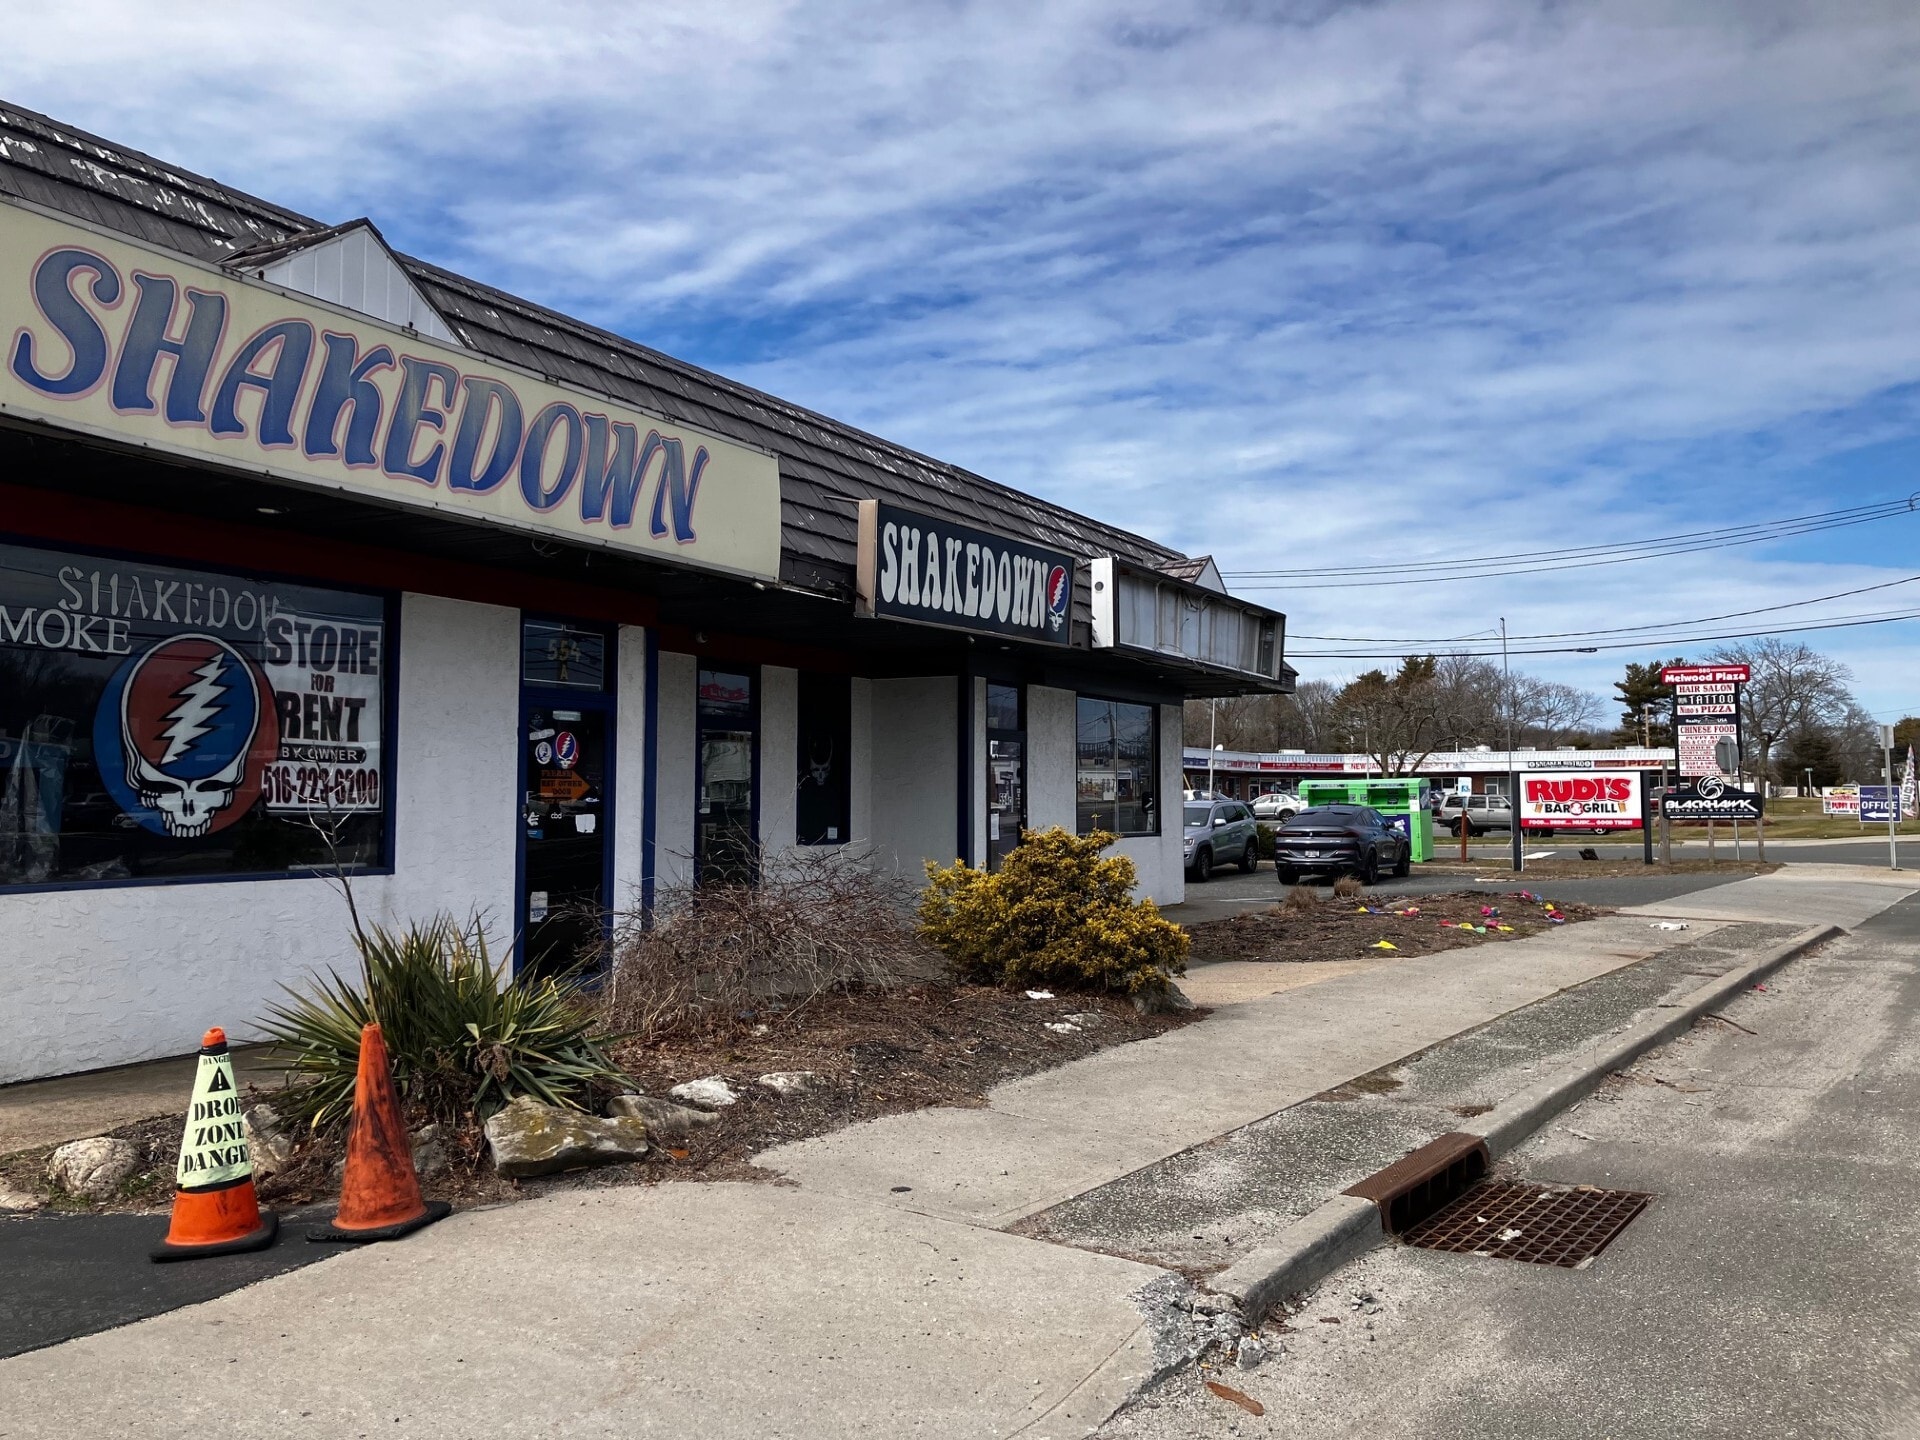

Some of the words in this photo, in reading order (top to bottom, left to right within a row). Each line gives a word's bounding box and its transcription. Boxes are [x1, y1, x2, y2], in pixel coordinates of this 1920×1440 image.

[8, 244, 710, 546] SHAKEDOWN
[881, 521, 1048, 630] SHAKEDOWN
[58, 566, 281, 632] SHAKEDOW
[0, 604, 132, 655] MOKE
[266, 616, 380, 676] STORE
[310, 673, 335, 692] FOR
[1664, 673, 1713, 683] Melwood
[1715, 672, 1746, 681] Plaza
[1679, 685, 1701, 693] HAIR
[1702, 684, 1733, 692] SALON
[1689, 694, 1734, 705] TATTOO
[276, 690, 366, 743] RENT
[1700, 705, 1733, 713] PIZZA
[1680, 726, 1712, 734] CHINESE
[1714, 725, 1735, 733] FOOD
[281, 746, 300, 758] BY
[307, 748, 358, 761] OWNER
[1525, 776, 1632, 803] RUDI'S
[1544, 803, 1570, 813] BAR
[1583, 803, 1617, 813] GRILL
[1665, 799, 1759, 812] BLACKHAWK
[1861, 801, 1898, 810] OFFICE
[202, 1054, 230, 1066] DANGE
[183, 1143, 249, 1174] DANGE
